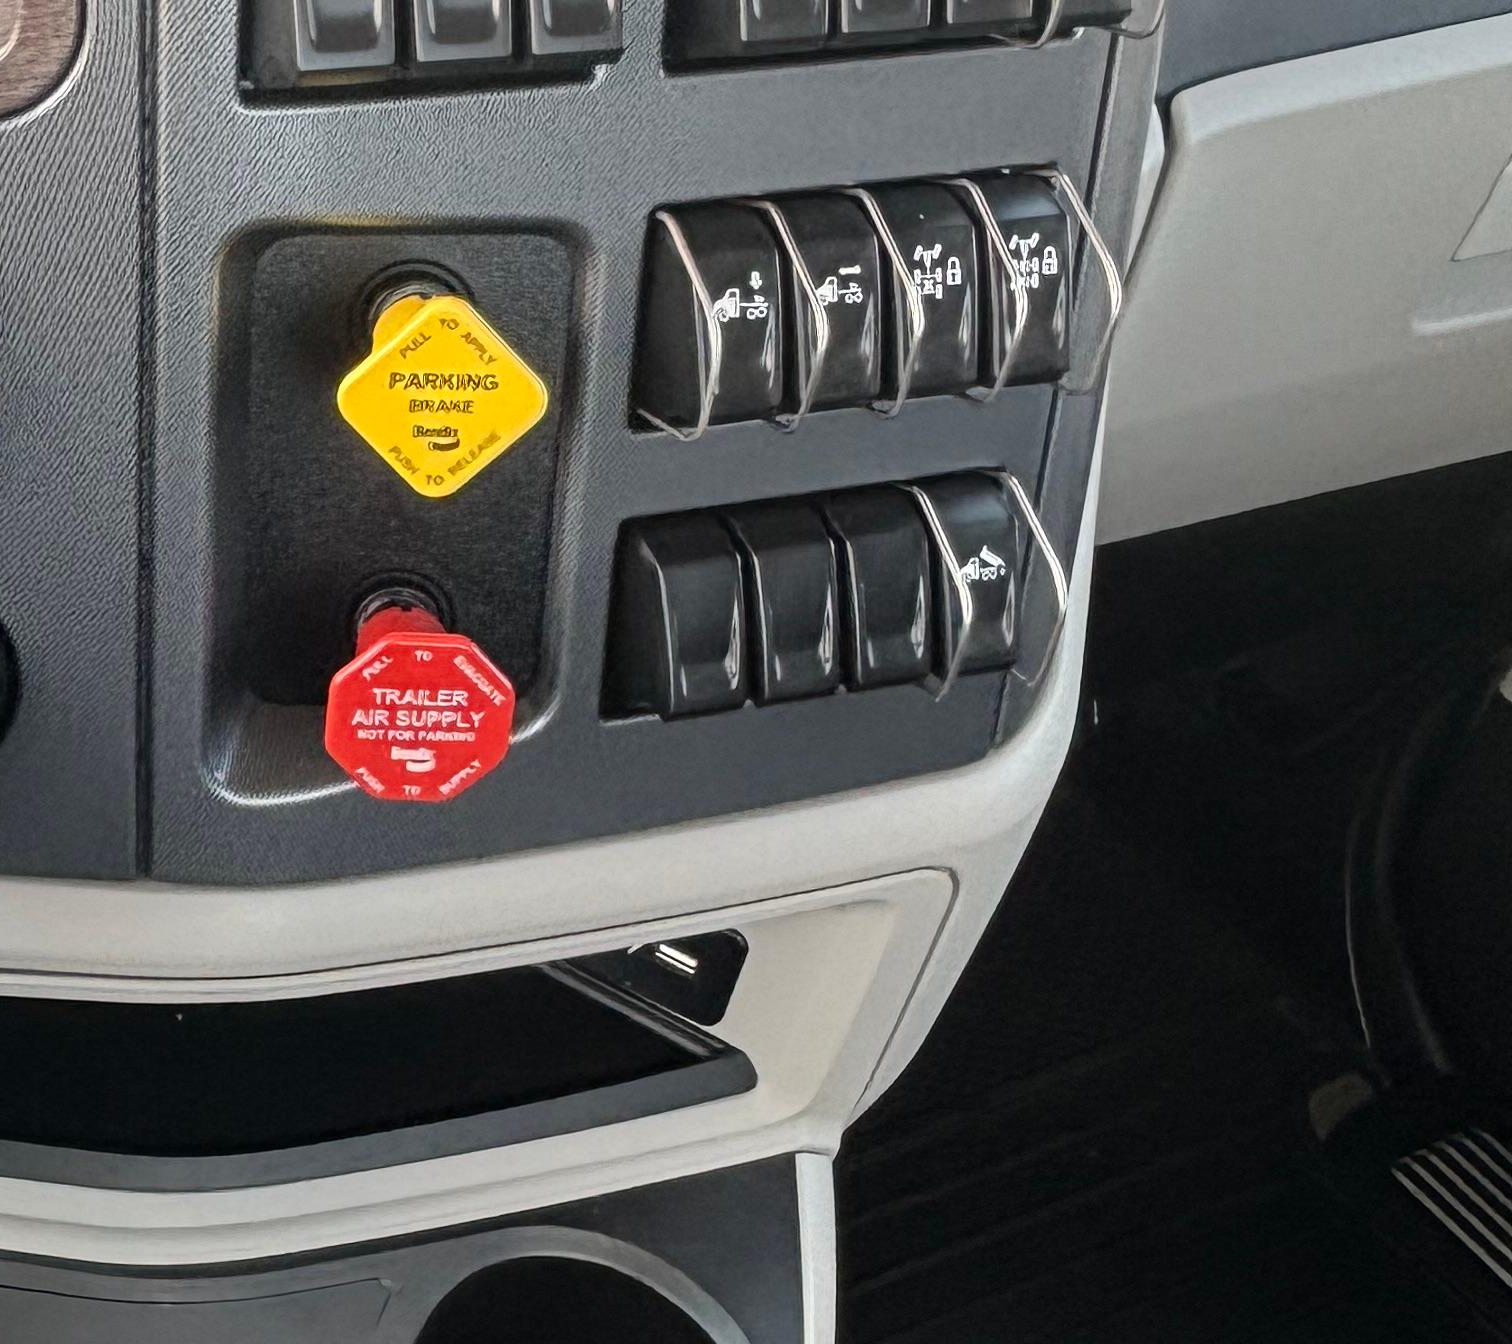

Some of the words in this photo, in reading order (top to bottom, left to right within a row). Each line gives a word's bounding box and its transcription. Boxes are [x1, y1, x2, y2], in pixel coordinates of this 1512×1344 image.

[399, 332, 432, 359] PULL
[439, 317, 460, 330] TO
[460, 331, 498, 366] APPLY
[389, 372, 499, 391] PARKING
[409, 398, 474, 415] BRAKE
[389, 445, 419, 476] PUSH
[425, 474, 445, 487] TO
[447, 430, 501, 476] RELEASE
[414, 649, 433, 662] TO
[372, 687, 469, 706] TRAILER
[351, 709, 390, 726] AIR
[395, 709, 486, 729] SUPPLY
[357, 729, 385, 741] NOT
[388, 729, 414, 741] FOR
[418, 731, 476, 742] PARKING
[403, 784, 423, 796] TO
